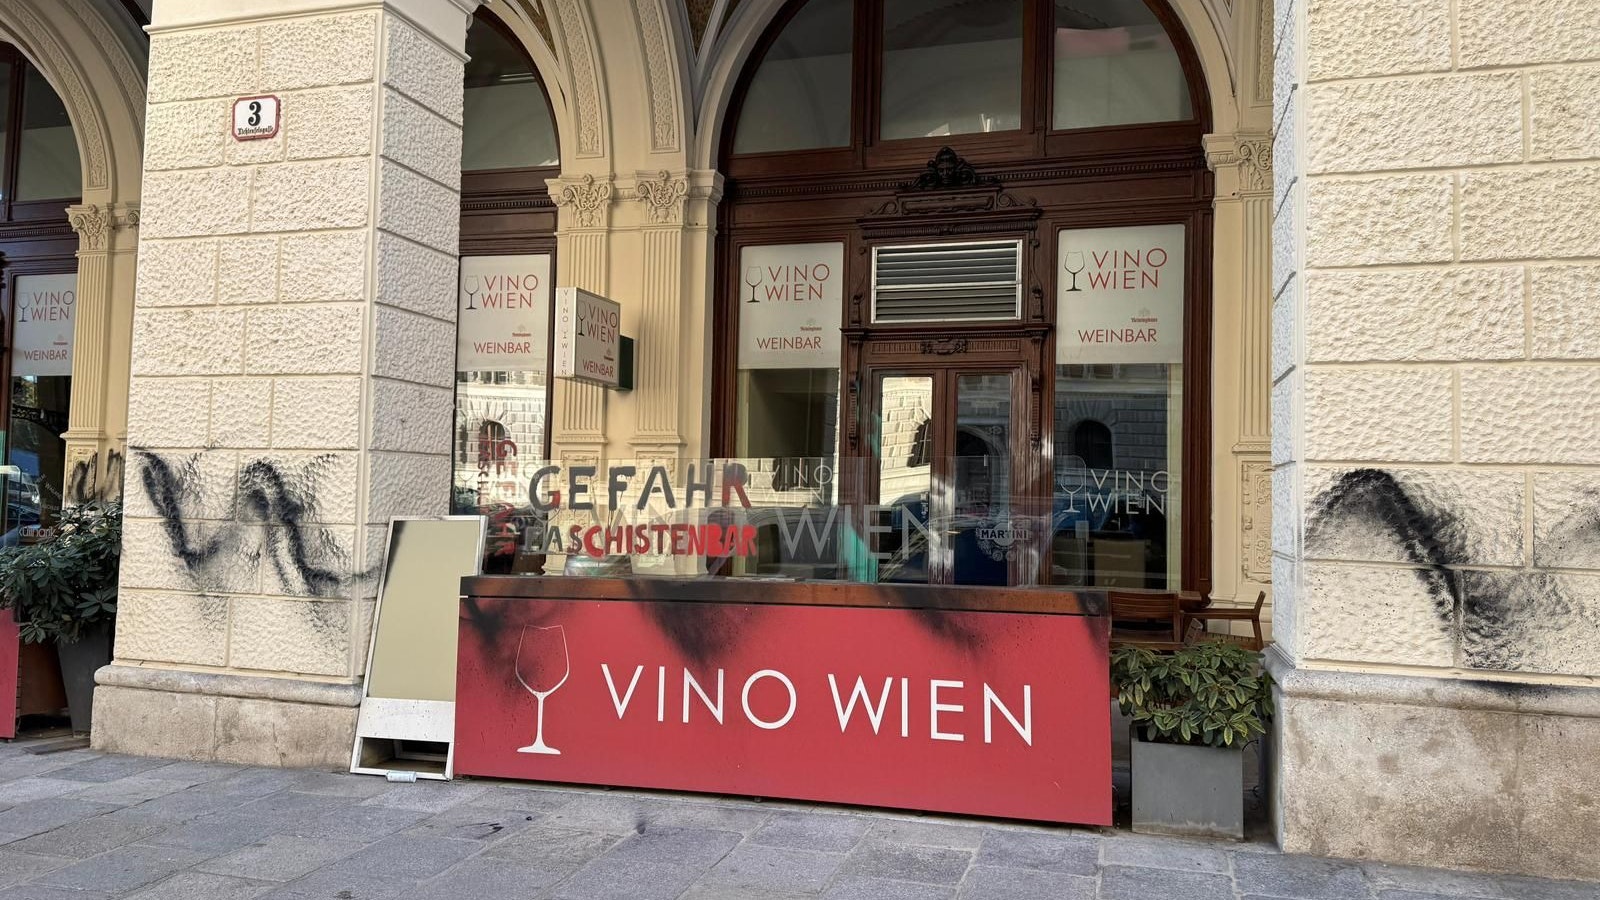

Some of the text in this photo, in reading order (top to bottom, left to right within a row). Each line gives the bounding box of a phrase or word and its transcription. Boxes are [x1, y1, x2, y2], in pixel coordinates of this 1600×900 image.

[248, 101, 262, 126] 3
[1091, 248, 1168, 269] VINO
[484, 274, 539, 291] VINO
[768, 263, 830, 282] VINO
[1088, 269, 1159, 290] WIEN
[33, 290, 75, 306] VINO
[481, 292, 532, 309] WIEN
[765, 283, 823, 302] WIEN
[31, 306, 70, 321] WIEN
[588, 303, 618, 329] VINO
[587, 320, 615, 344] WIEN
[1078, 328, 1158, 343] WEINBAR
[473, 341, 531, 354] WEINBAR
[756, 336, 823, 350] WEINBAR
[24, 349, 68, 361] WEINBAR
[561, 342, 569, 375] WIEN
[582, 358, 614, 378] WEINBAR
[765, 464, 833, 485] VINO
[1090, 469, 1171, 493] VINO
[528, 462, 752, 512] GEFAHR
[1087, 493, 1166, 515] WIEN
[774, 503, 947, 560] WIEN
[981, 529, 1028, 540] MARTINI
[601, 662, 1033, 747] VINO WIEN
